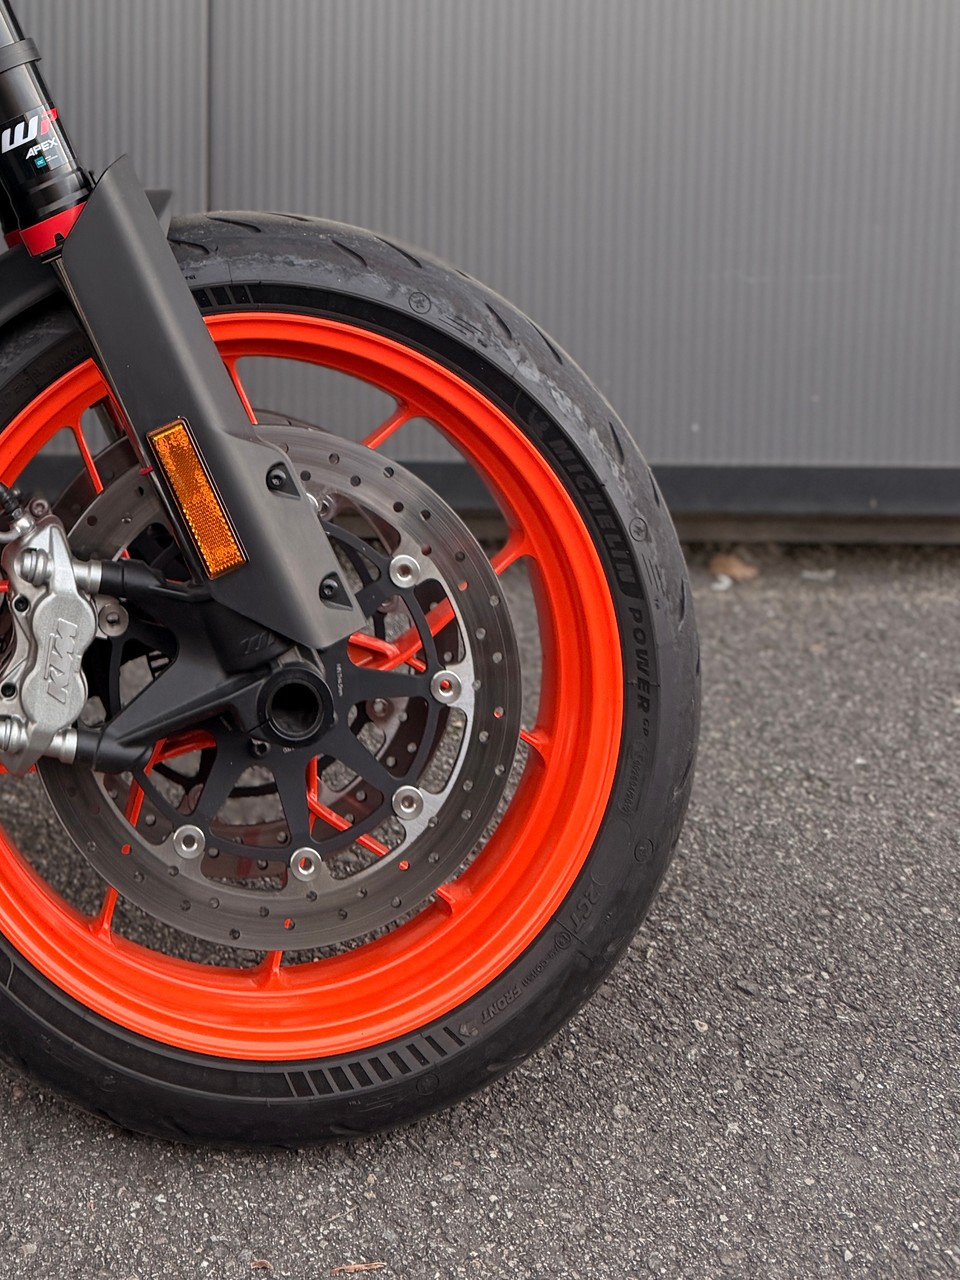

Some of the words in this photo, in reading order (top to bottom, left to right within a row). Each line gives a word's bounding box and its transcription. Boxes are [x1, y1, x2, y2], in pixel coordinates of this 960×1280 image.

[25, 137, 59, 160] APEX
[549, 435, 636, 587] MICHELIN
[628, 607, 651, 713] POWER
[642, 718, 651, 738] GP
[44, 618, 78, 704] KTM
[480, 984, 524, 1024] FRONT
